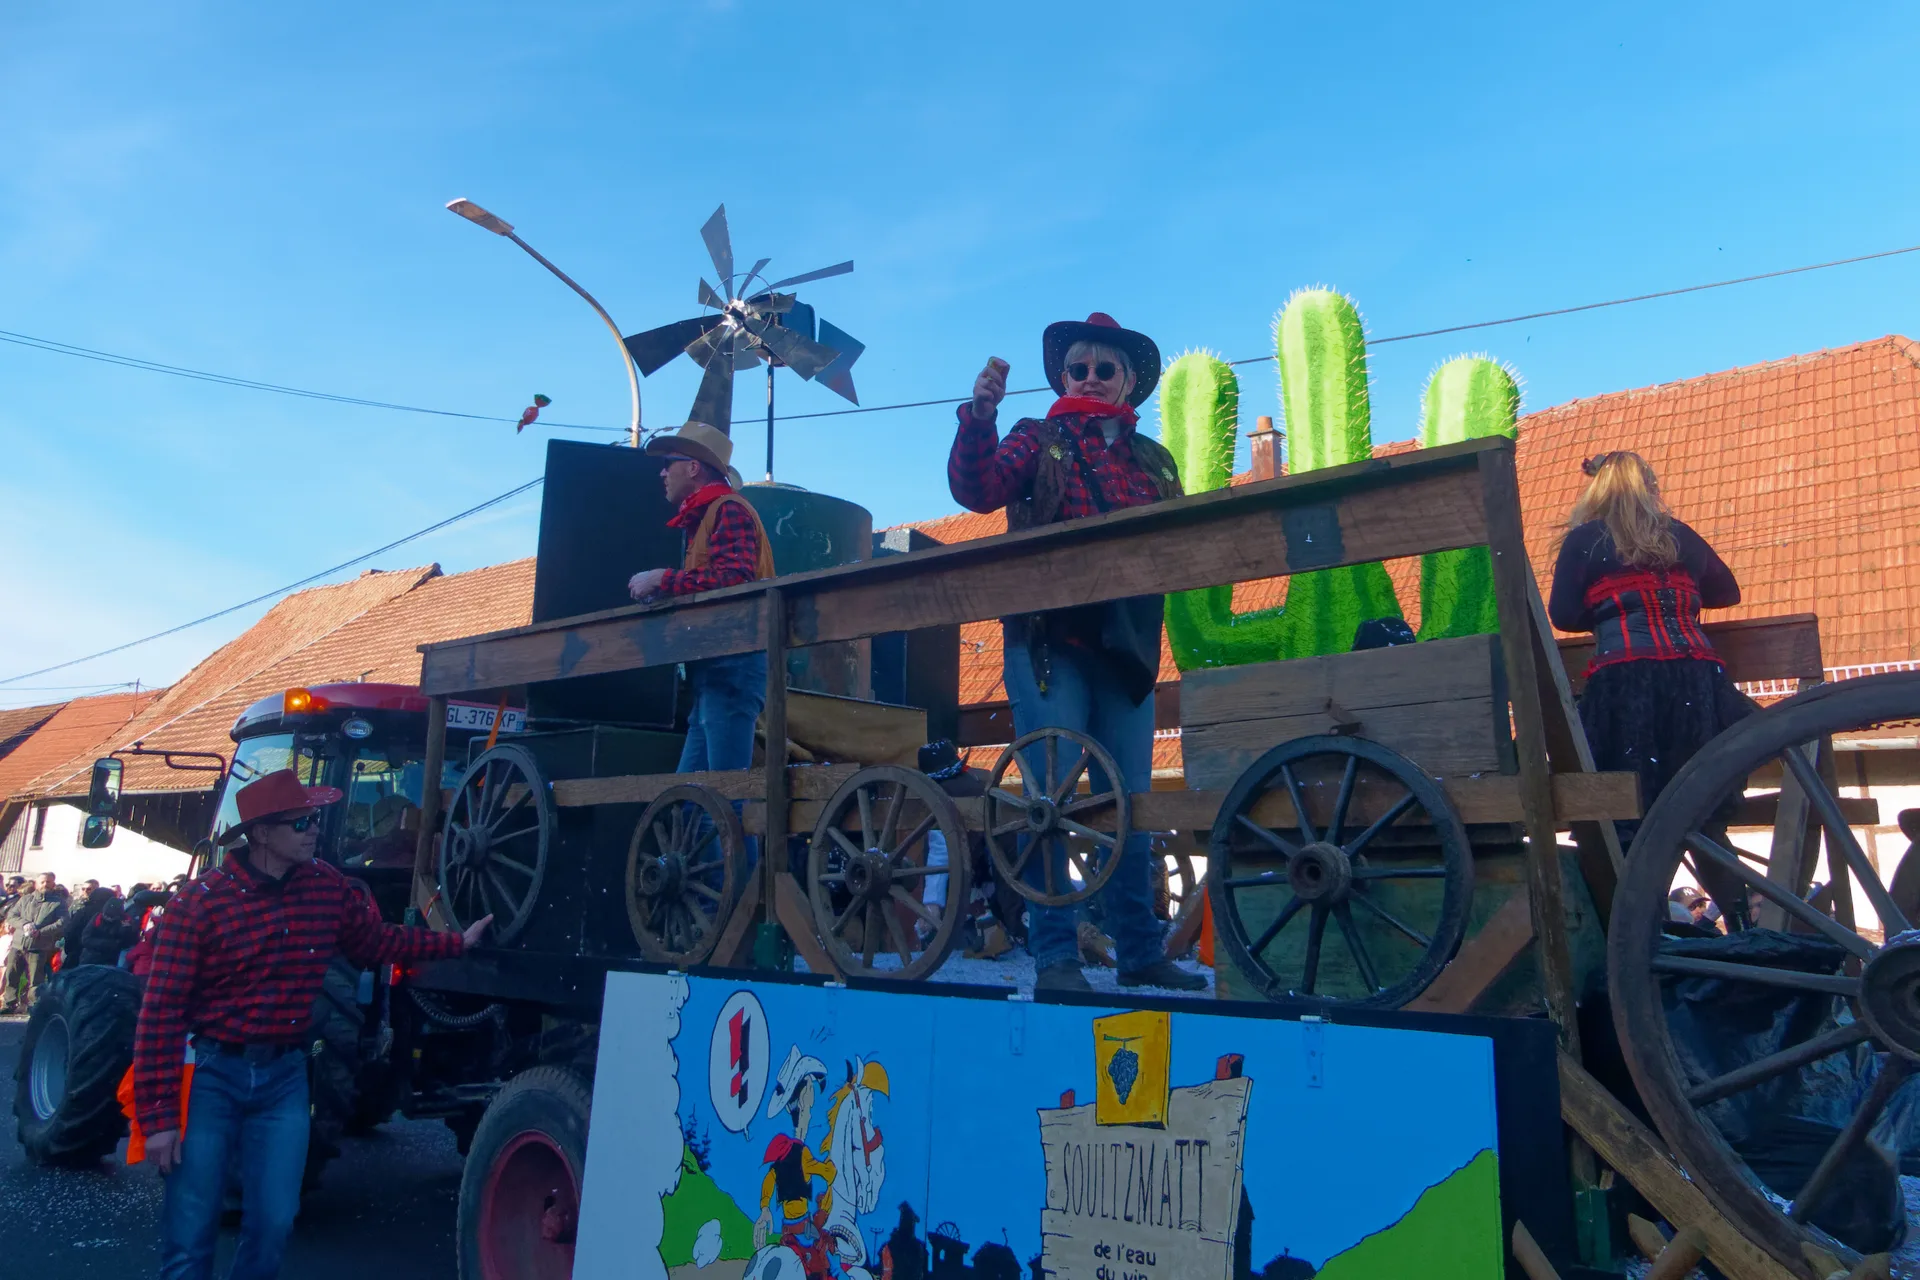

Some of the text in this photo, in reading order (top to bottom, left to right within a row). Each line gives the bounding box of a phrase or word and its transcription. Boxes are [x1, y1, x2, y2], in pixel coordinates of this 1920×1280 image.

[1063, 1140, 1211, 1233] SOULTZMATT
[1094, 1239, 1156, 1266] de l'eau
[1096, 1264, 1115, 1280] du
